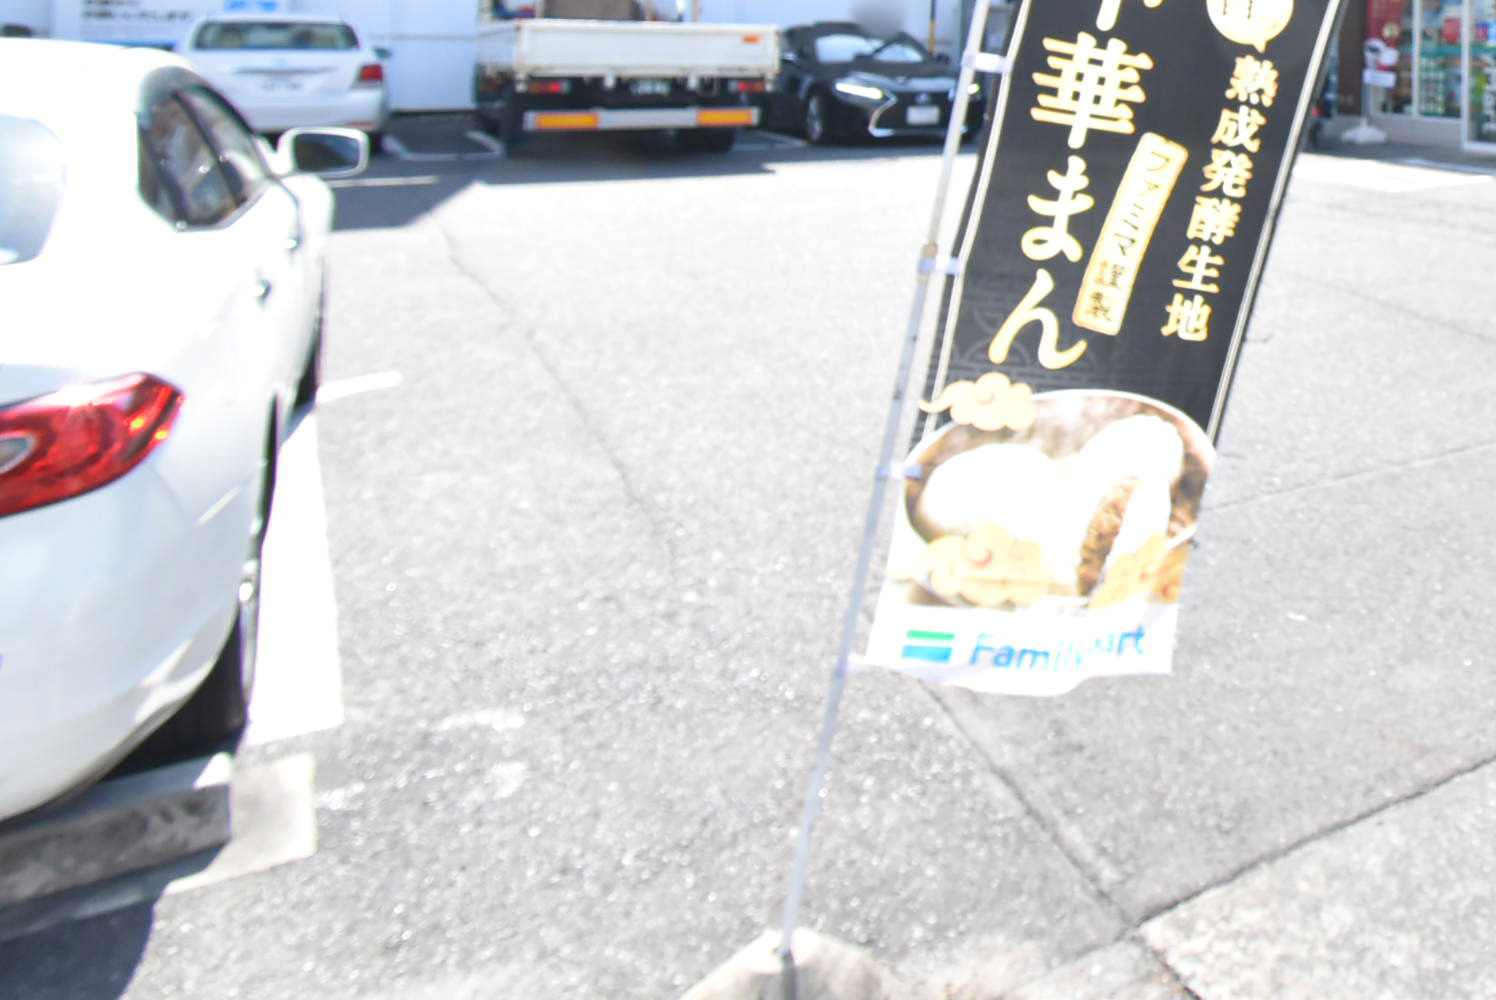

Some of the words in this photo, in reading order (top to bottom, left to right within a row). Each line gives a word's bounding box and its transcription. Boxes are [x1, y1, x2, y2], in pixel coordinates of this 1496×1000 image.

[1161, 55, 1279, 341] 熟成発酵生地
